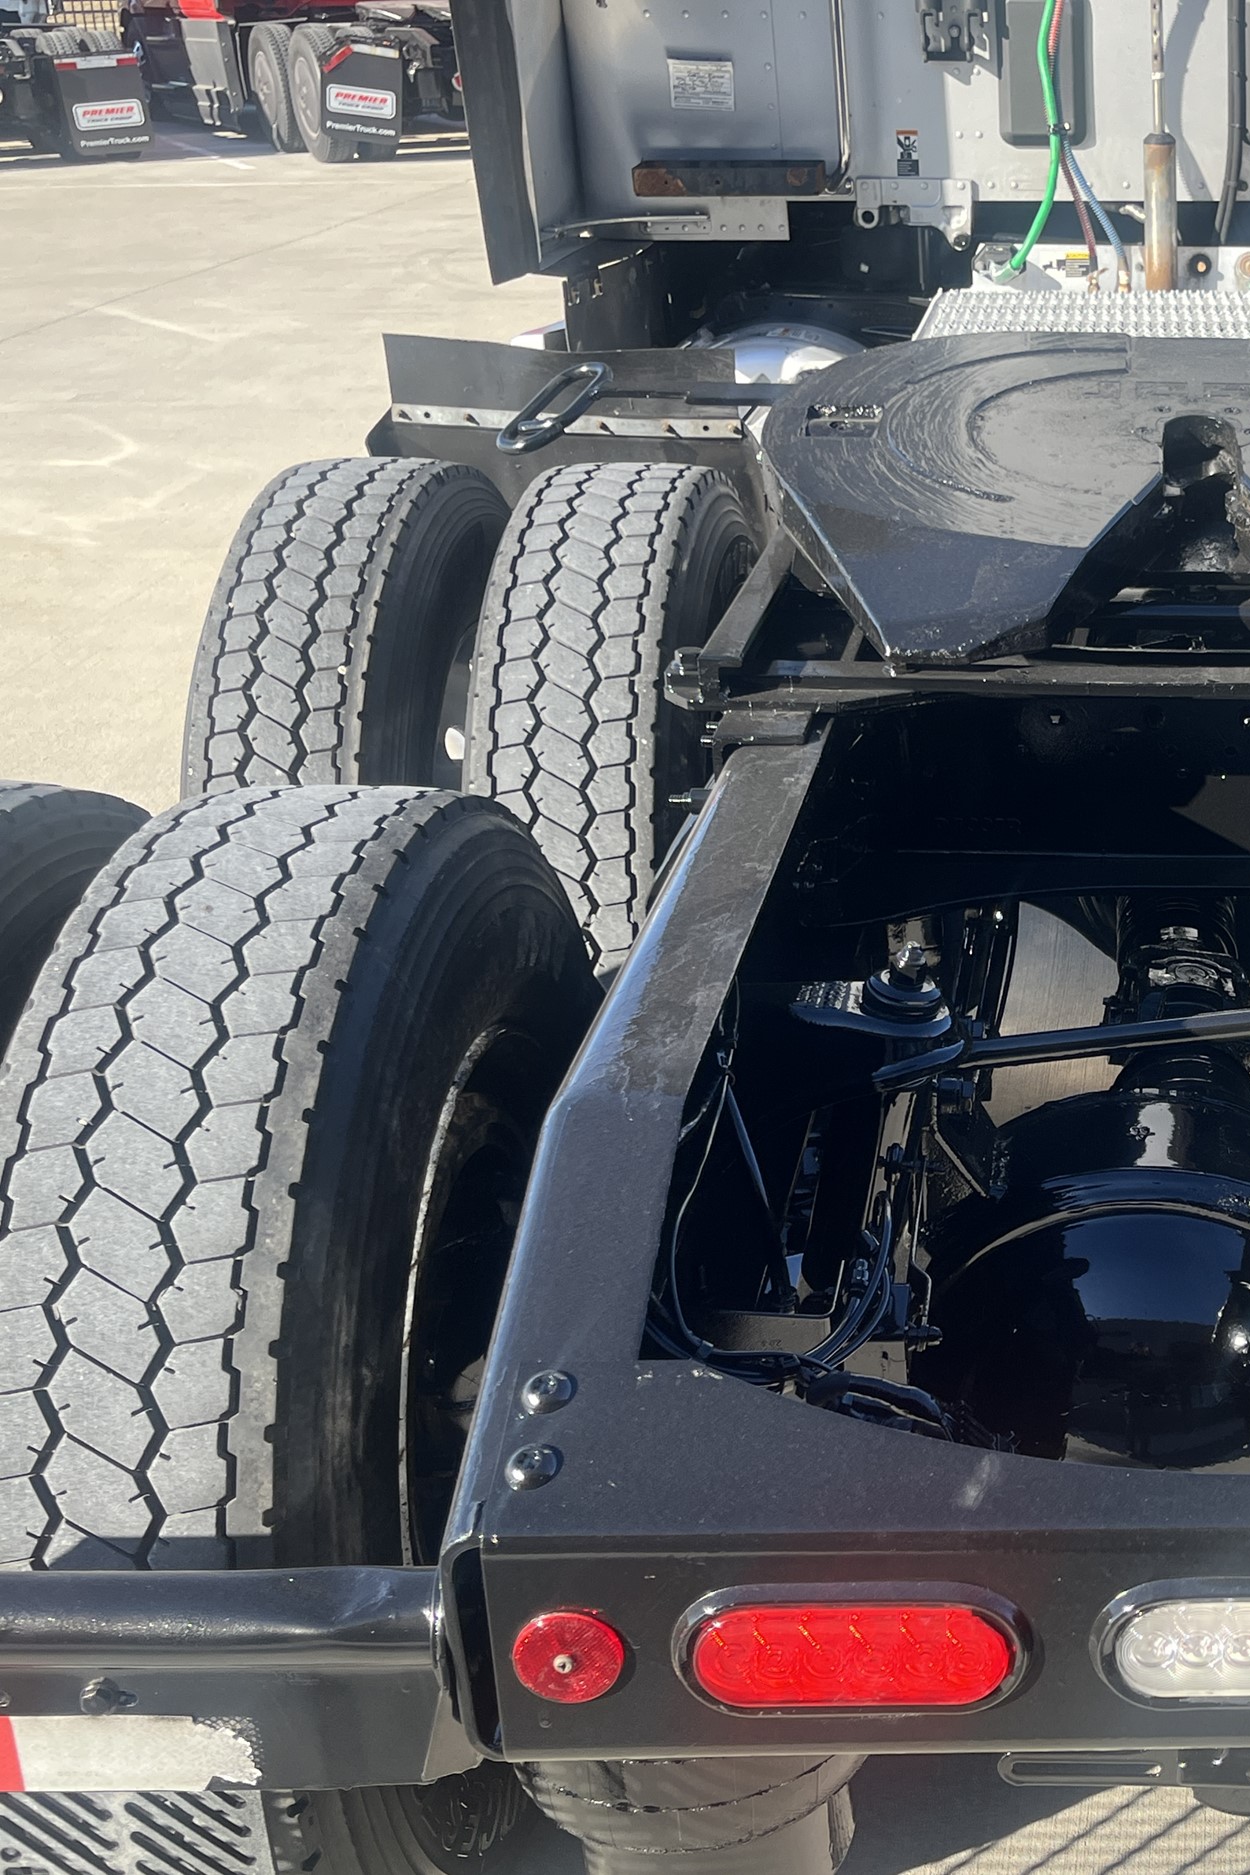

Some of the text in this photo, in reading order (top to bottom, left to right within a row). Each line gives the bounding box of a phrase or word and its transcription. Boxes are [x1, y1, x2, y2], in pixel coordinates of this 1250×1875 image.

[335, 92, 388, 104] PREMIER
[82, 106, 135, 118] PREMIER
[326, 120, 396, 137] PremierTruck.com
